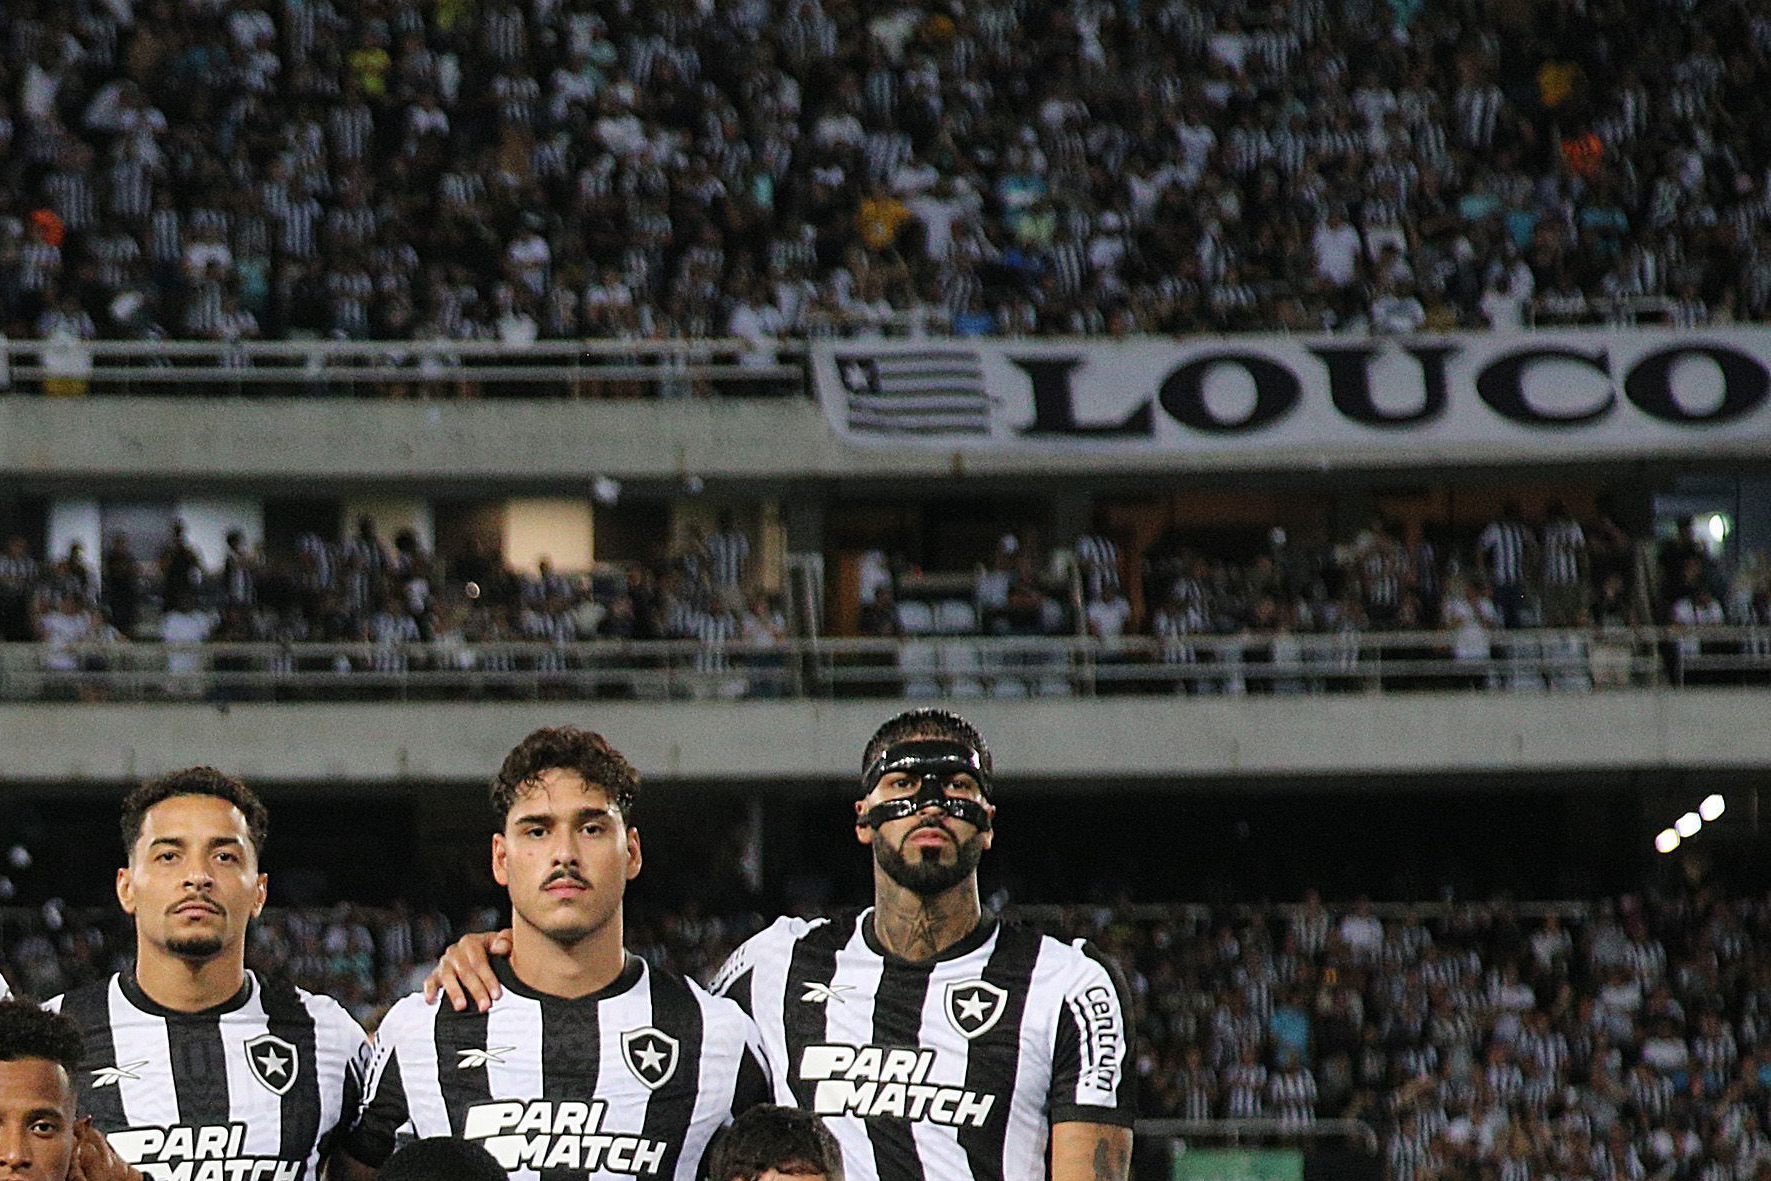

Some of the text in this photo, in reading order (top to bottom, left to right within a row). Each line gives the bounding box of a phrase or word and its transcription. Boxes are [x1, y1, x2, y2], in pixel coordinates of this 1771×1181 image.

[1009, 343, 1771, 440] LOUCO
[1085, 986, 1118, 1092] Centrum
[798, 1045, 934, 1084] PARI
[463, 1101, 605, 1140] PARI
[813, 1079, 996, 1127] MATCH
[106, 1125, 244, 1164] PARI
[483, 1133, 668, 1175] MATCH
